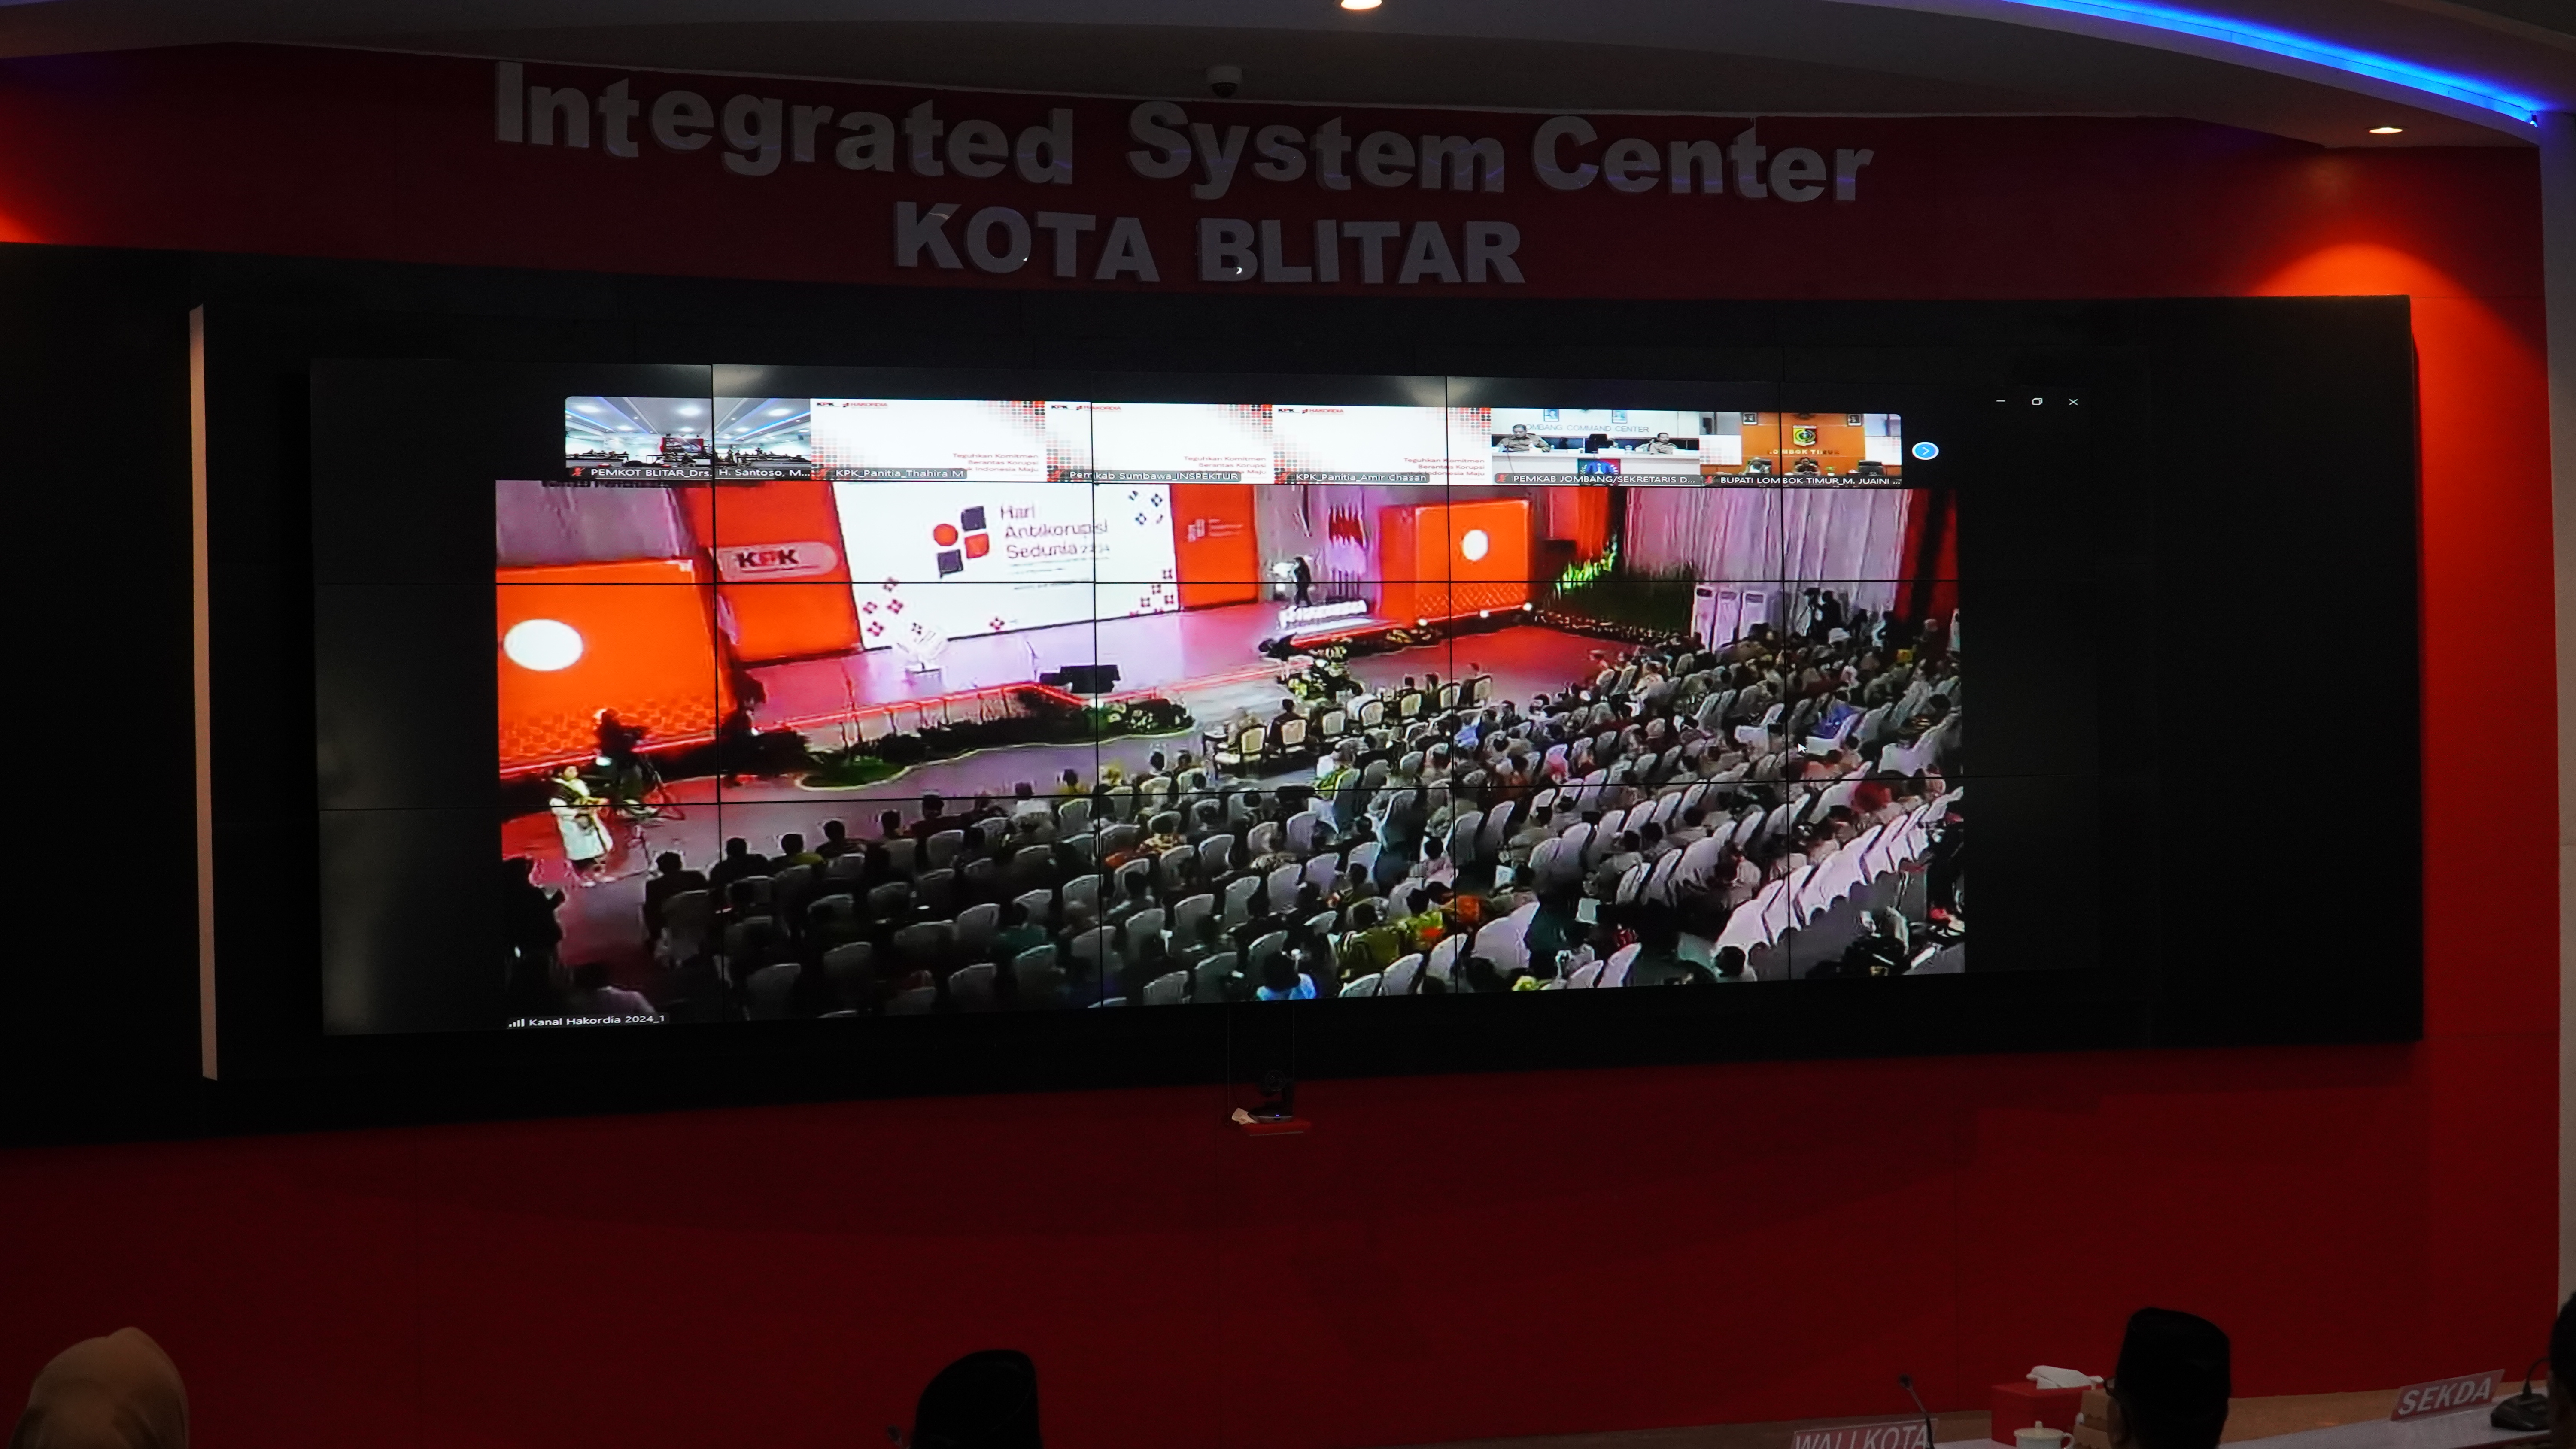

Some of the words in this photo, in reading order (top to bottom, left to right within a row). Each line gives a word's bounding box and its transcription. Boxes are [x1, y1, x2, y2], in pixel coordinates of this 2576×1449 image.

[495, 61, 1074, 185] Integrated
[1127, 100, 1504, 200] System
[1530, 115, 1874, 202] Center
[894, 201, 1161, 282] KOTA
[1197, 218, 1525, 285] BLITAR
[590, 469, 642, 477] PEMKOT
[645, 469, 713, 479] BLITAR_Drs.
[718, 469, 731, 477] H.
[735, 469, 785, 478] Santoso,
[835, 469, 948, 479] KPK_Panitia_Thahira
[1118, 472, 1239, 481] Sumbawa_INSPEKTUR
[1295, 473, 1385, 482] KPK_Panitia_Amir
[1388, 473, 1427, 482] Chasan
[1560, 475, 1677, 484] JOMBANG/SEKRETARIS
[1756, 477, 1803, 485] LOMBOK
[1806, 477, 1856, 485] TIMUR_M.
[1858, 478, 1889, 486] JUAINI
[1000, 503, 1035, 520] Hari
[1006, 541, 1078, 559] Sedunia
[529, 1018, 562, 1027] Kanal
[566, 1016, 621, 1025] Hakordia
[625, 1015, 665, 1024] 2024_1
[2397, 1377, 2492, 1416] SEKDA
